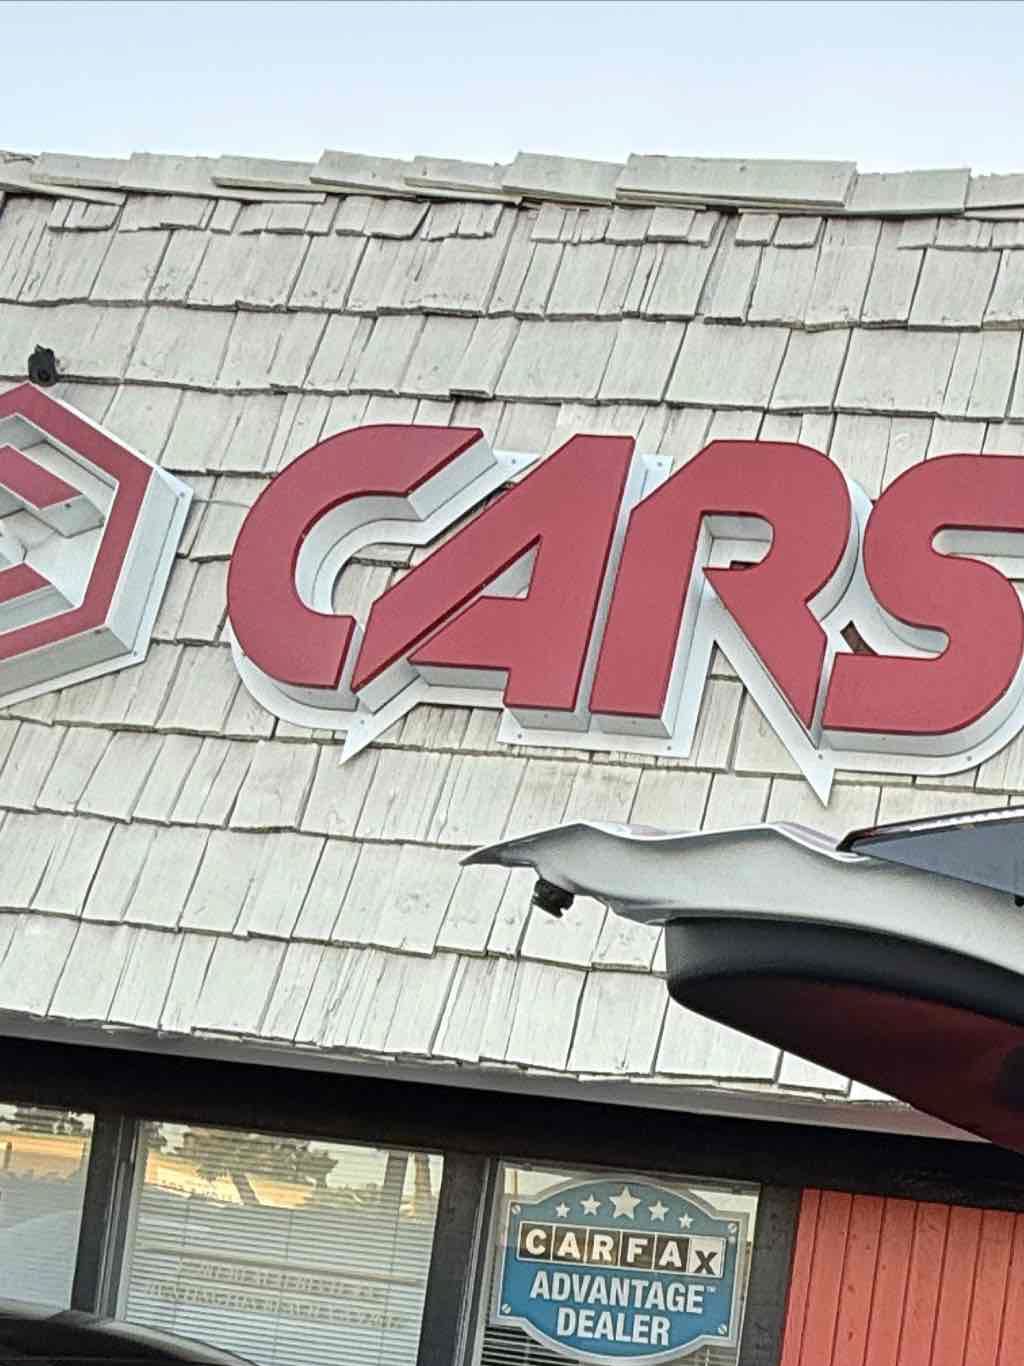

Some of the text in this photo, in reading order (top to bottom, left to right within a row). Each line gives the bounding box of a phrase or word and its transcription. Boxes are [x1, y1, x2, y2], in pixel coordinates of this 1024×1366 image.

[525, 1228, 717, 1275] CARFAX
[530, 1270, 705, 1314] ADVANTAGE
[556, 1307, 671, 1346] DEALER
